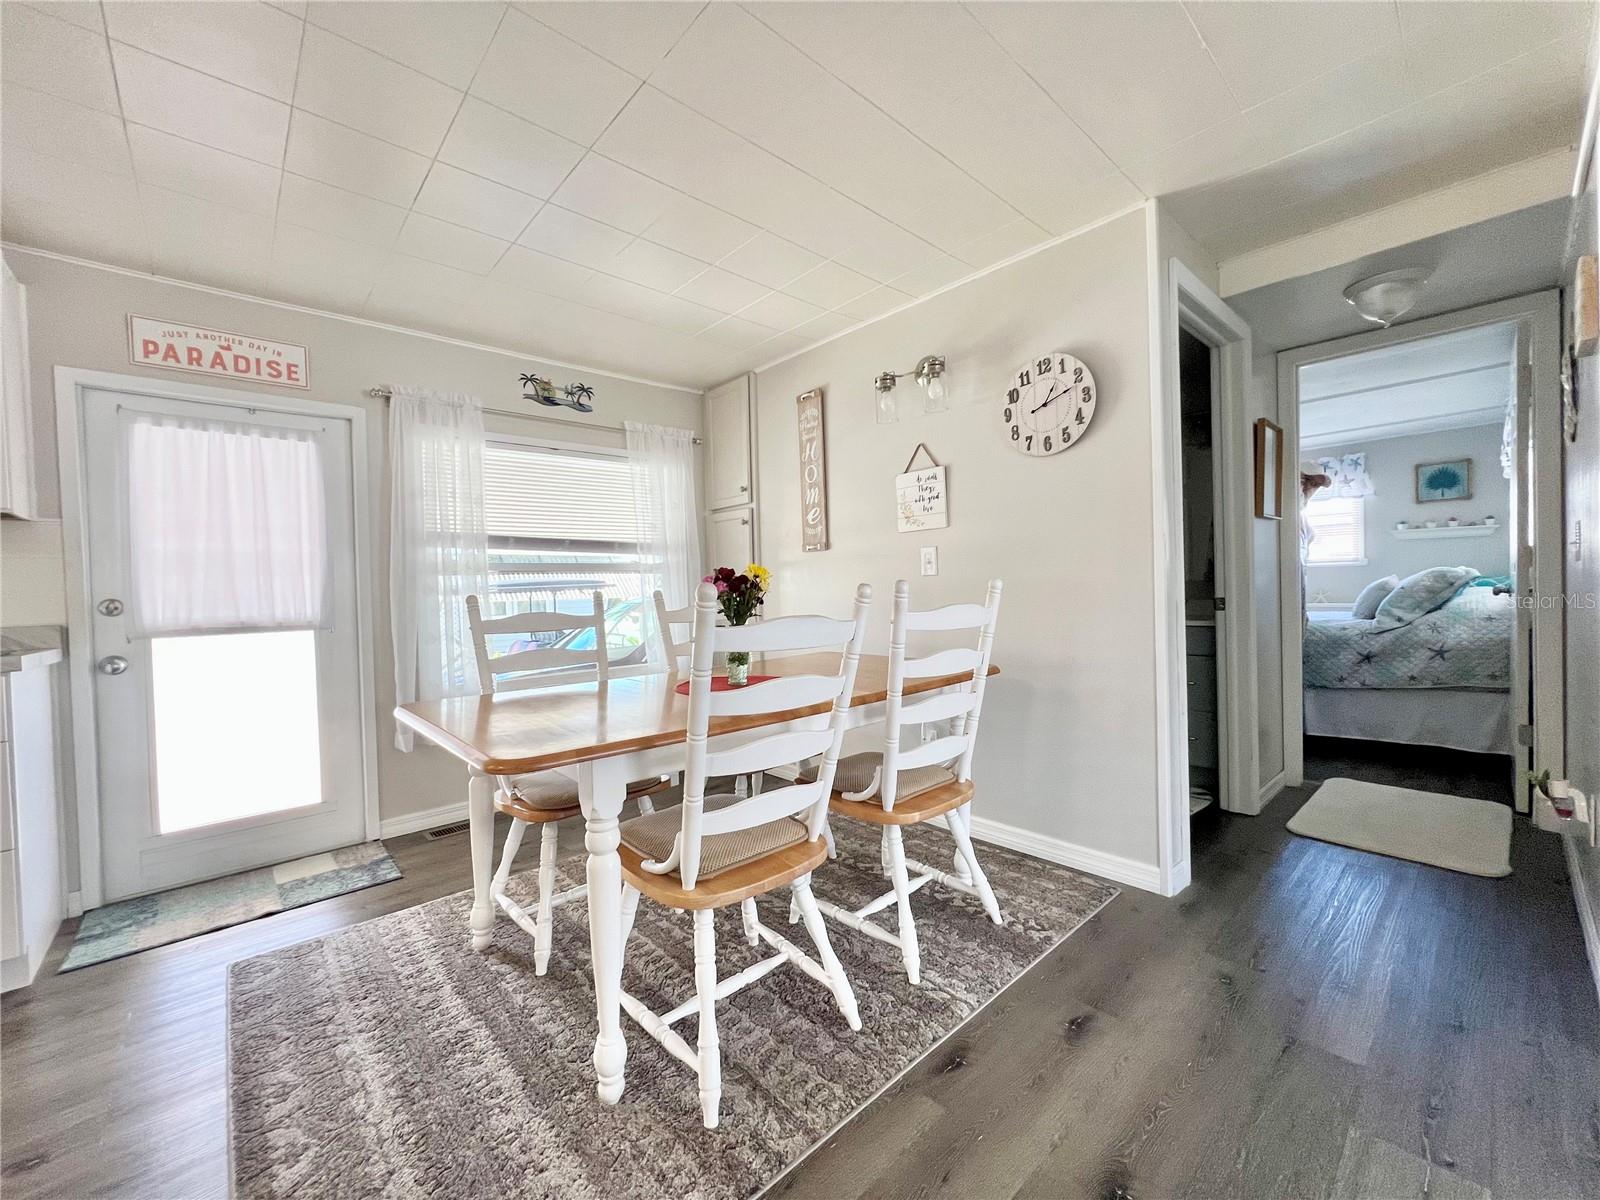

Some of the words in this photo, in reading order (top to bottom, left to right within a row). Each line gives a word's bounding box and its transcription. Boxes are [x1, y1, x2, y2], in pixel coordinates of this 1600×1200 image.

[161, 330, 189, 339] JUST
[195, 333, 244, 346] ANOTHER
[248, 343, 268, 353] DAY
[272, 349, 282, 357] IN
[142, 338, 300, 382] PARADISE
[1036, 357, 1052, 376] 12
[1058, 358, 1067, 374] 1
[1018, 370, 1032, 388] 11
[1073, 367, 1084, 384] 2
[1006, 388, 1020, 405] 10
[1081, 386, 1092, 403] 3
[1003, 407, 1012, 423] 9
[1074, 407, 1085, 425] 4
[1011, 424, 1020, 441] 8
[1062, 426, 1071, 443] 5
[1025, 435, 1033, 451] 7
[1043, 435, 1052, 452] 6
